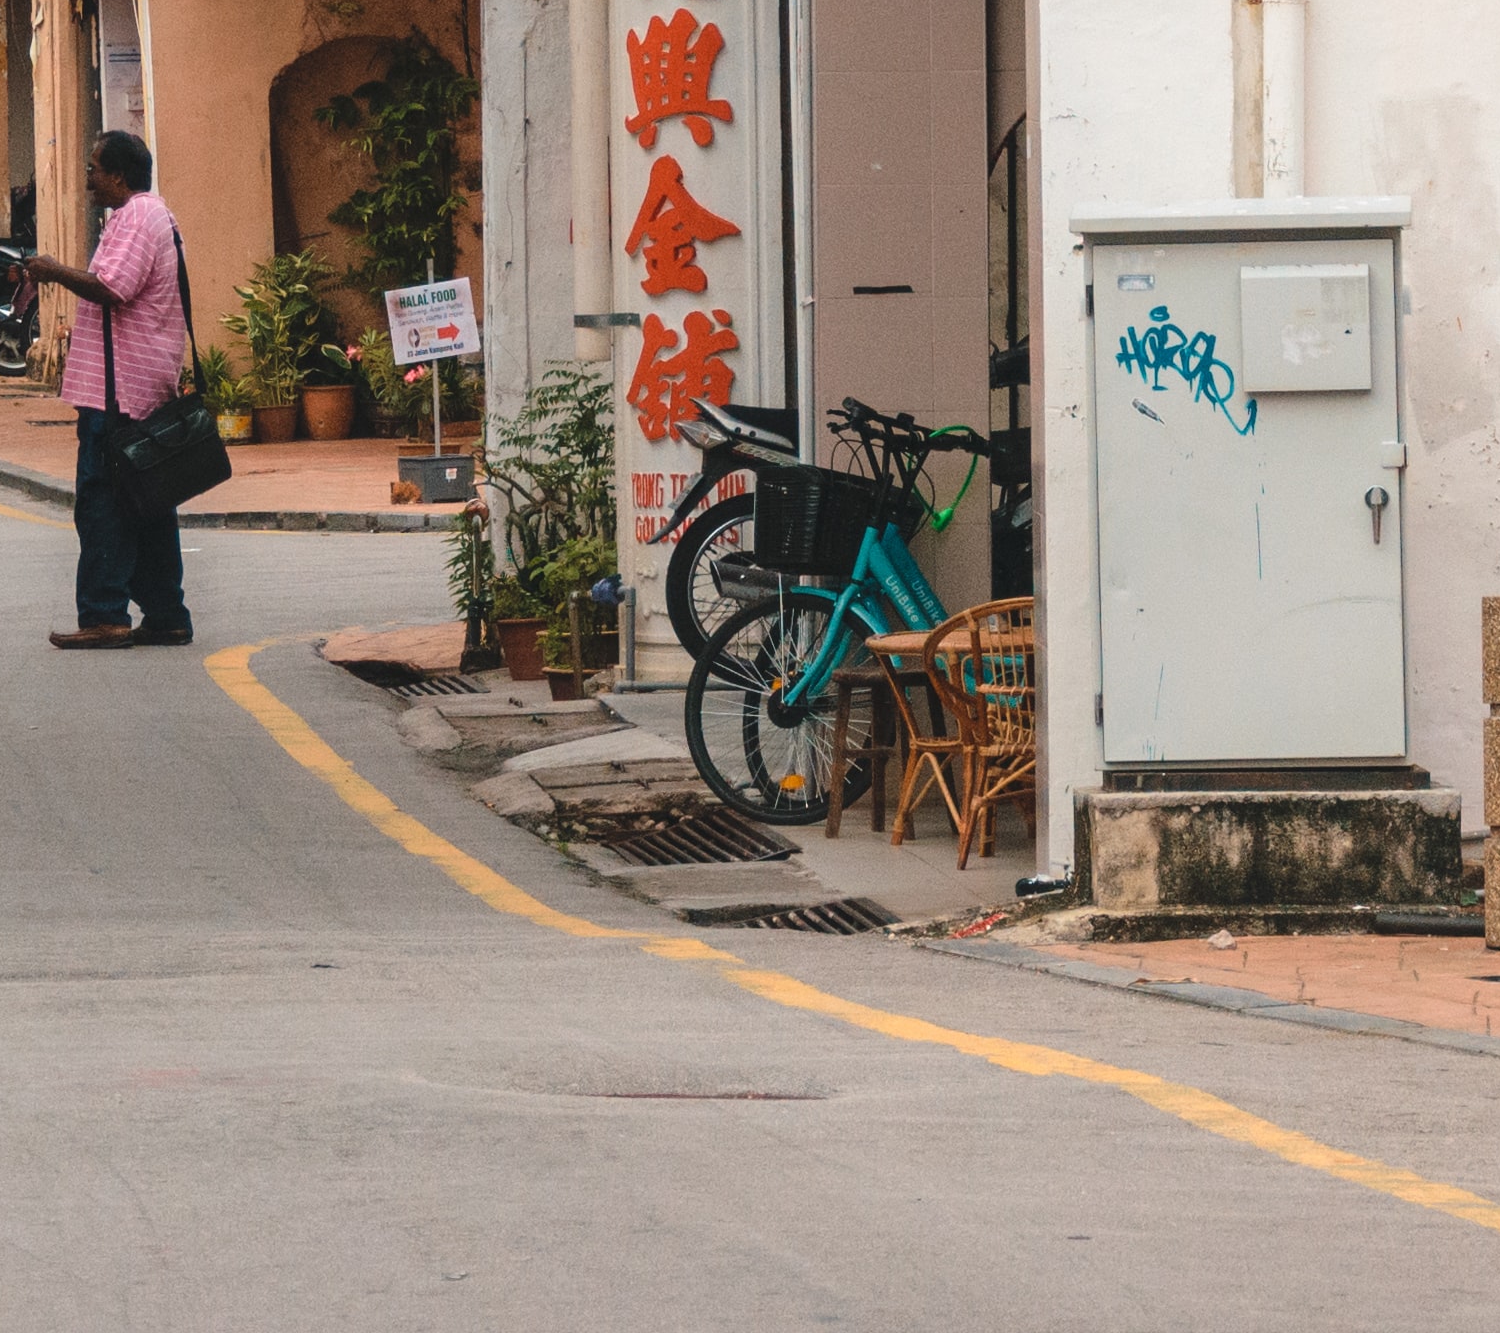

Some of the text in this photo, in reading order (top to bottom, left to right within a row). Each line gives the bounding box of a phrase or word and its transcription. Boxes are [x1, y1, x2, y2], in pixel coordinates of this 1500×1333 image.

[399, 288, 457, 309] HALAL FOOD
[885, 575, 919, 623] UniBike
